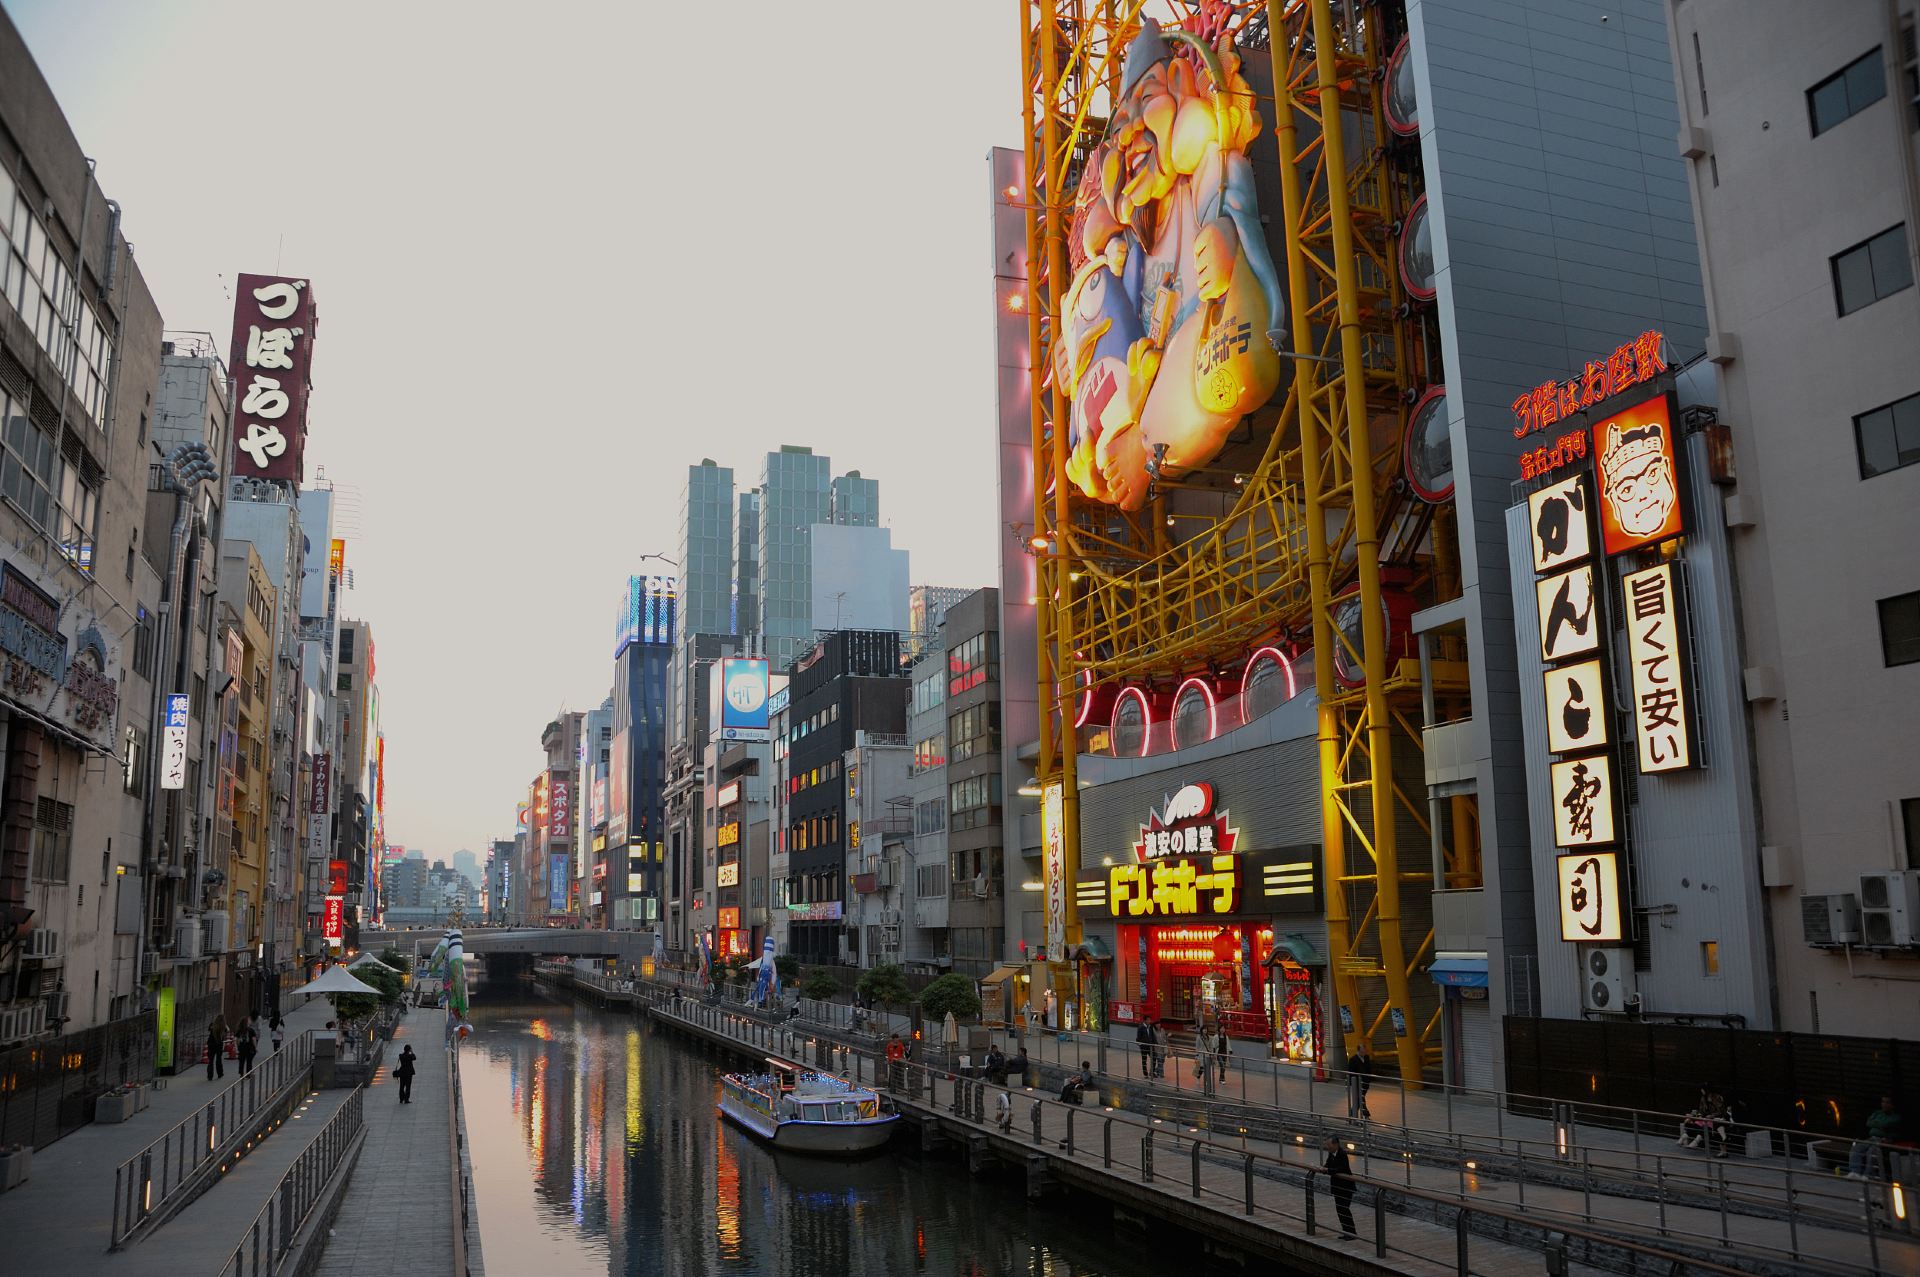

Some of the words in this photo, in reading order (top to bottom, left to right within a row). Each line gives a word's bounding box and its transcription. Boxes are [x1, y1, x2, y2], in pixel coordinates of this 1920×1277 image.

[239, 280, 306, 468] づぼらや
[1511, 329, 1667, 439] 3階はお座敷
[1631, 572, 1679, 764] 旨くて安い
[172, 696, 187, 726] 焼肉
[169, 729, 184, 786] いろりや
[553, 783, 568, 835] スポタカ
[1144, 826, 1213, 858] 激安の殿堂
[1049, 822, 1060, 935] えびすタワー
